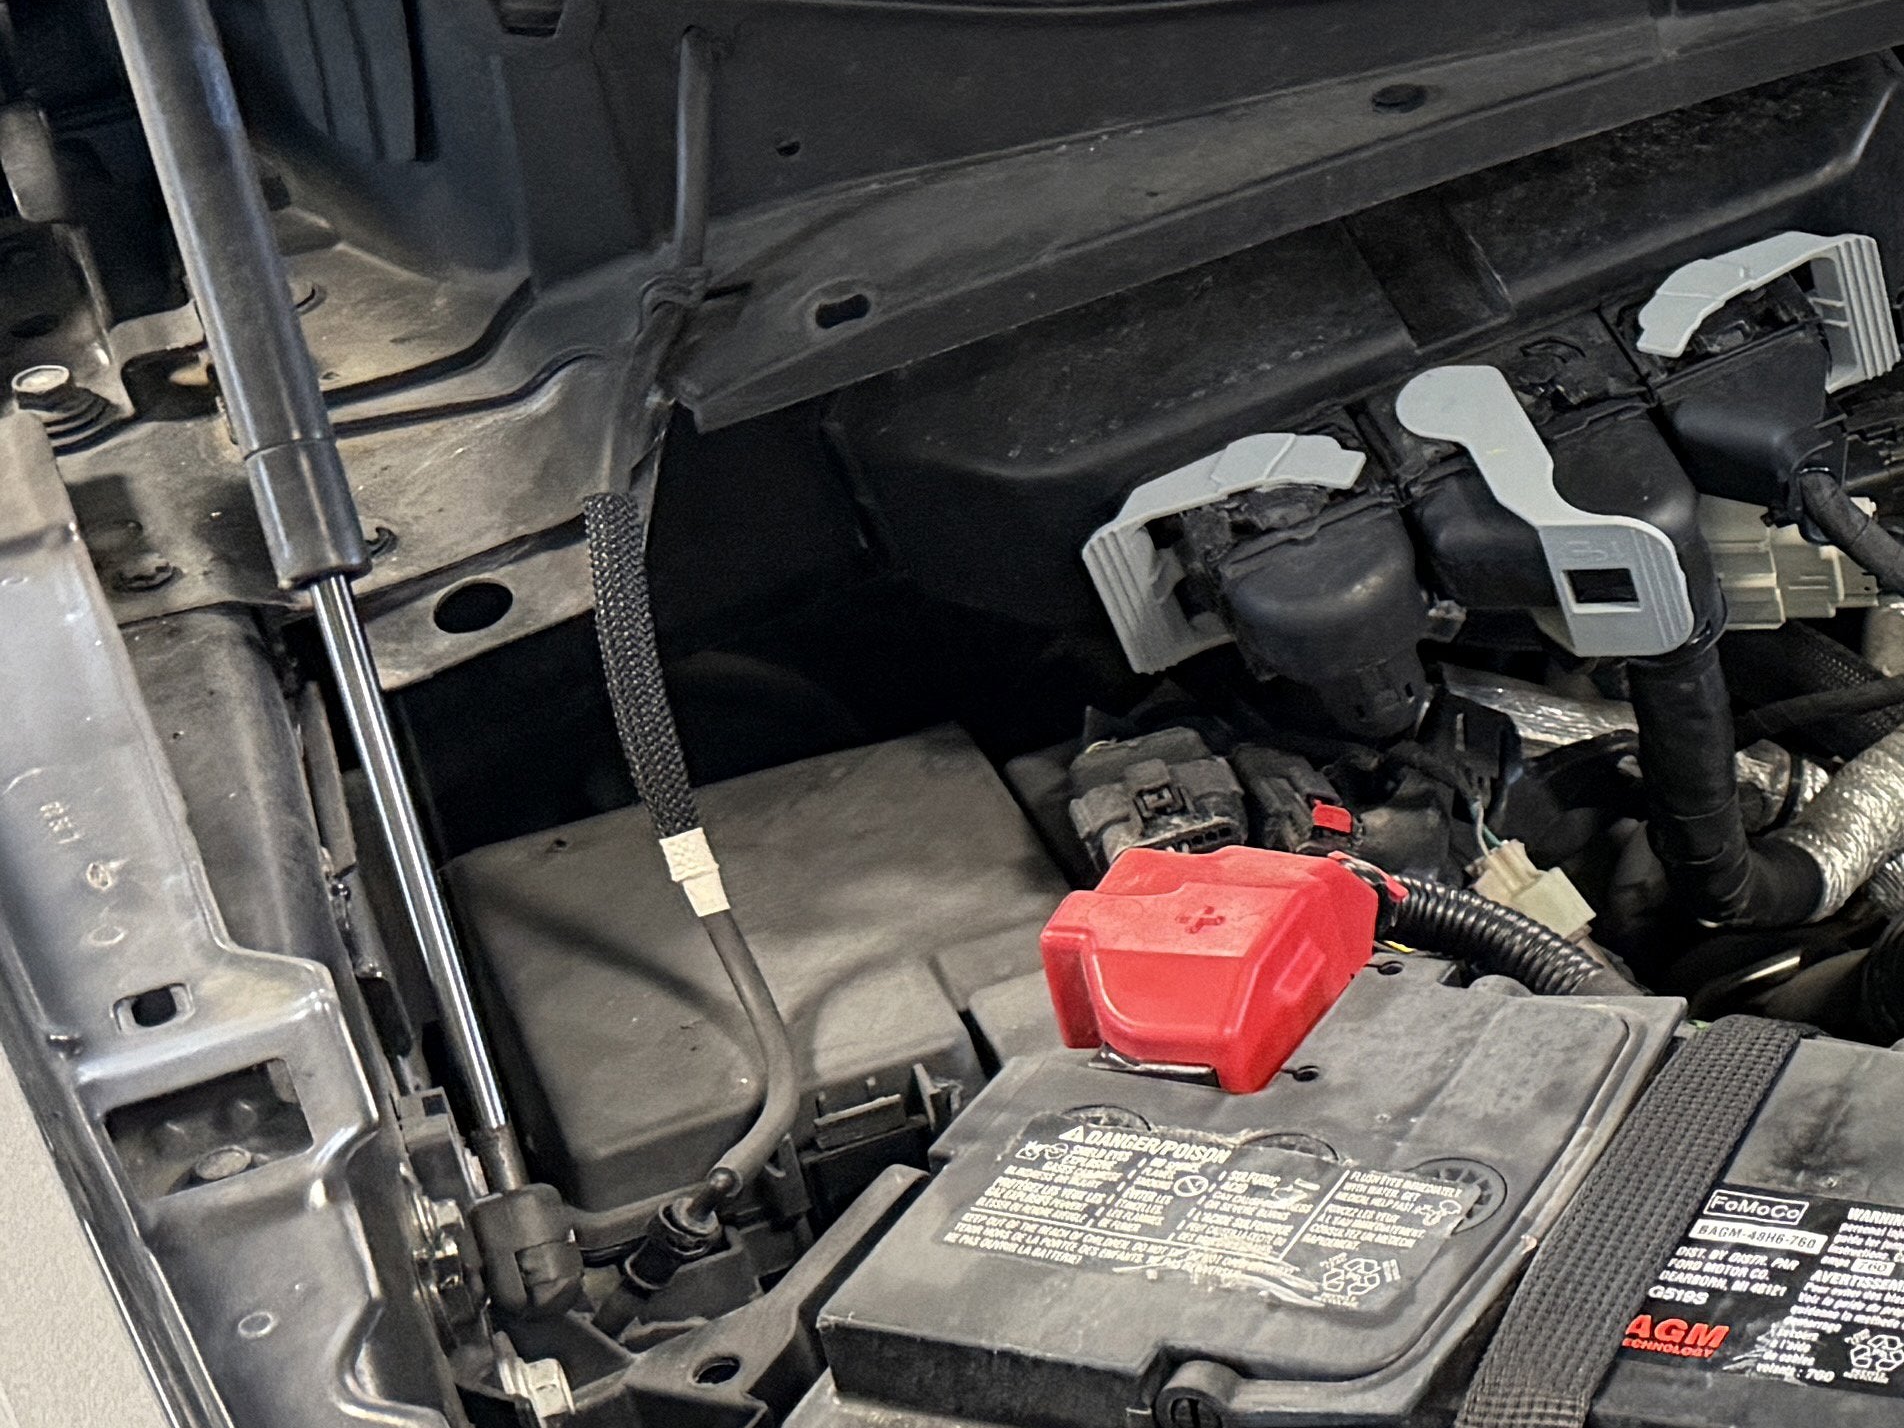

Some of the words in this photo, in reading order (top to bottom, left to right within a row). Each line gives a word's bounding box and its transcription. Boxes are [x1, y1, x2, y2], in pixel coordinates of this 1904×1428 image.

[1086, 1130, 1232, 1164] DANGER/POISON
[1711, 1196, 1800, 1219] FoMoCo
[1667, 1259, 1703, 1271] FORD
[1703, 1262, 1749, 1278] MOTOR
[1625, 1315, 1730, 1348] AGM
